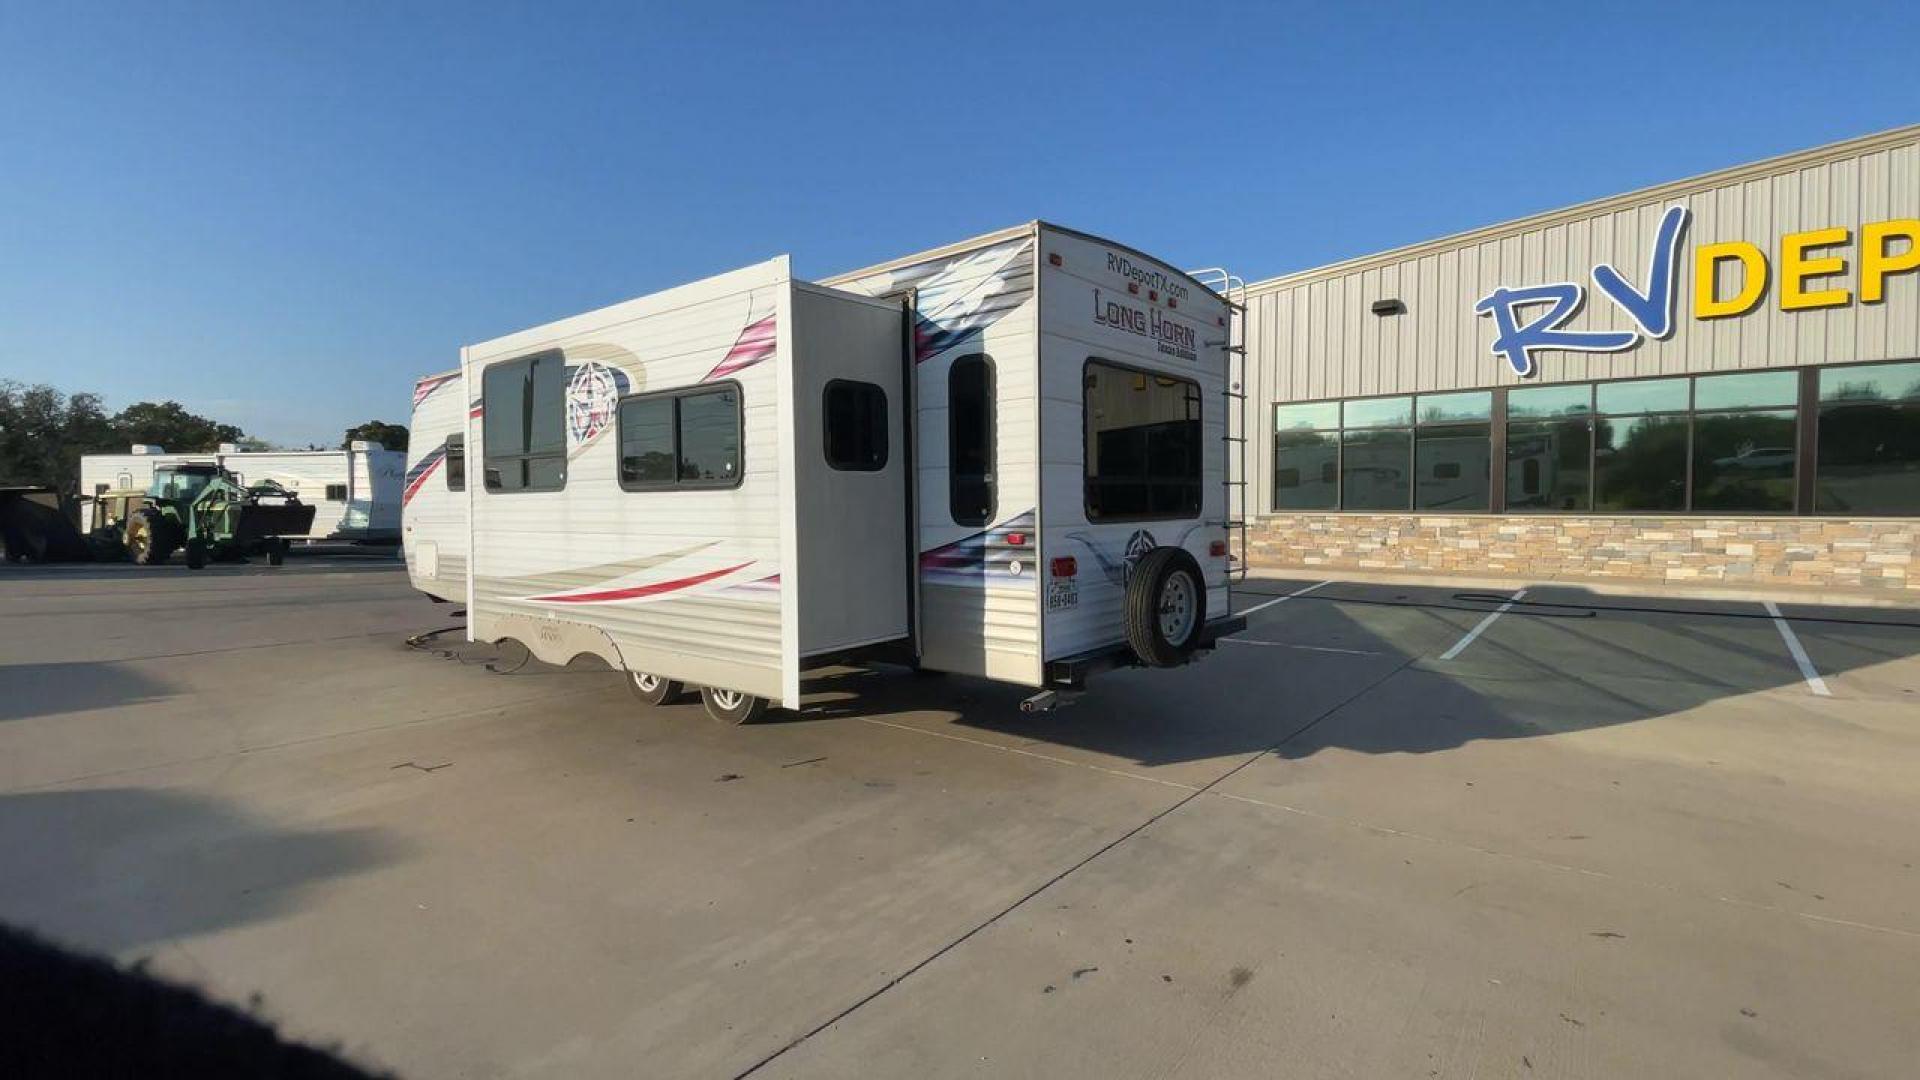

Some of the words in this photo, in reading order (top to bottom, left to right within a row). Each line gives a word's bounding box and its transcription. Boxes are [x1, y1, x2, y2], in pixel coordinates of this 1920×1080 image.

[1107, 252, 1188, 300] RVDepotTX.com
[1475, 205, 1688, 376] RV
[1695, 218, 1920, 321] DEP
[1094, 288, 1146, 334] LONG
[1150, 307, 1195, 347] HORN
